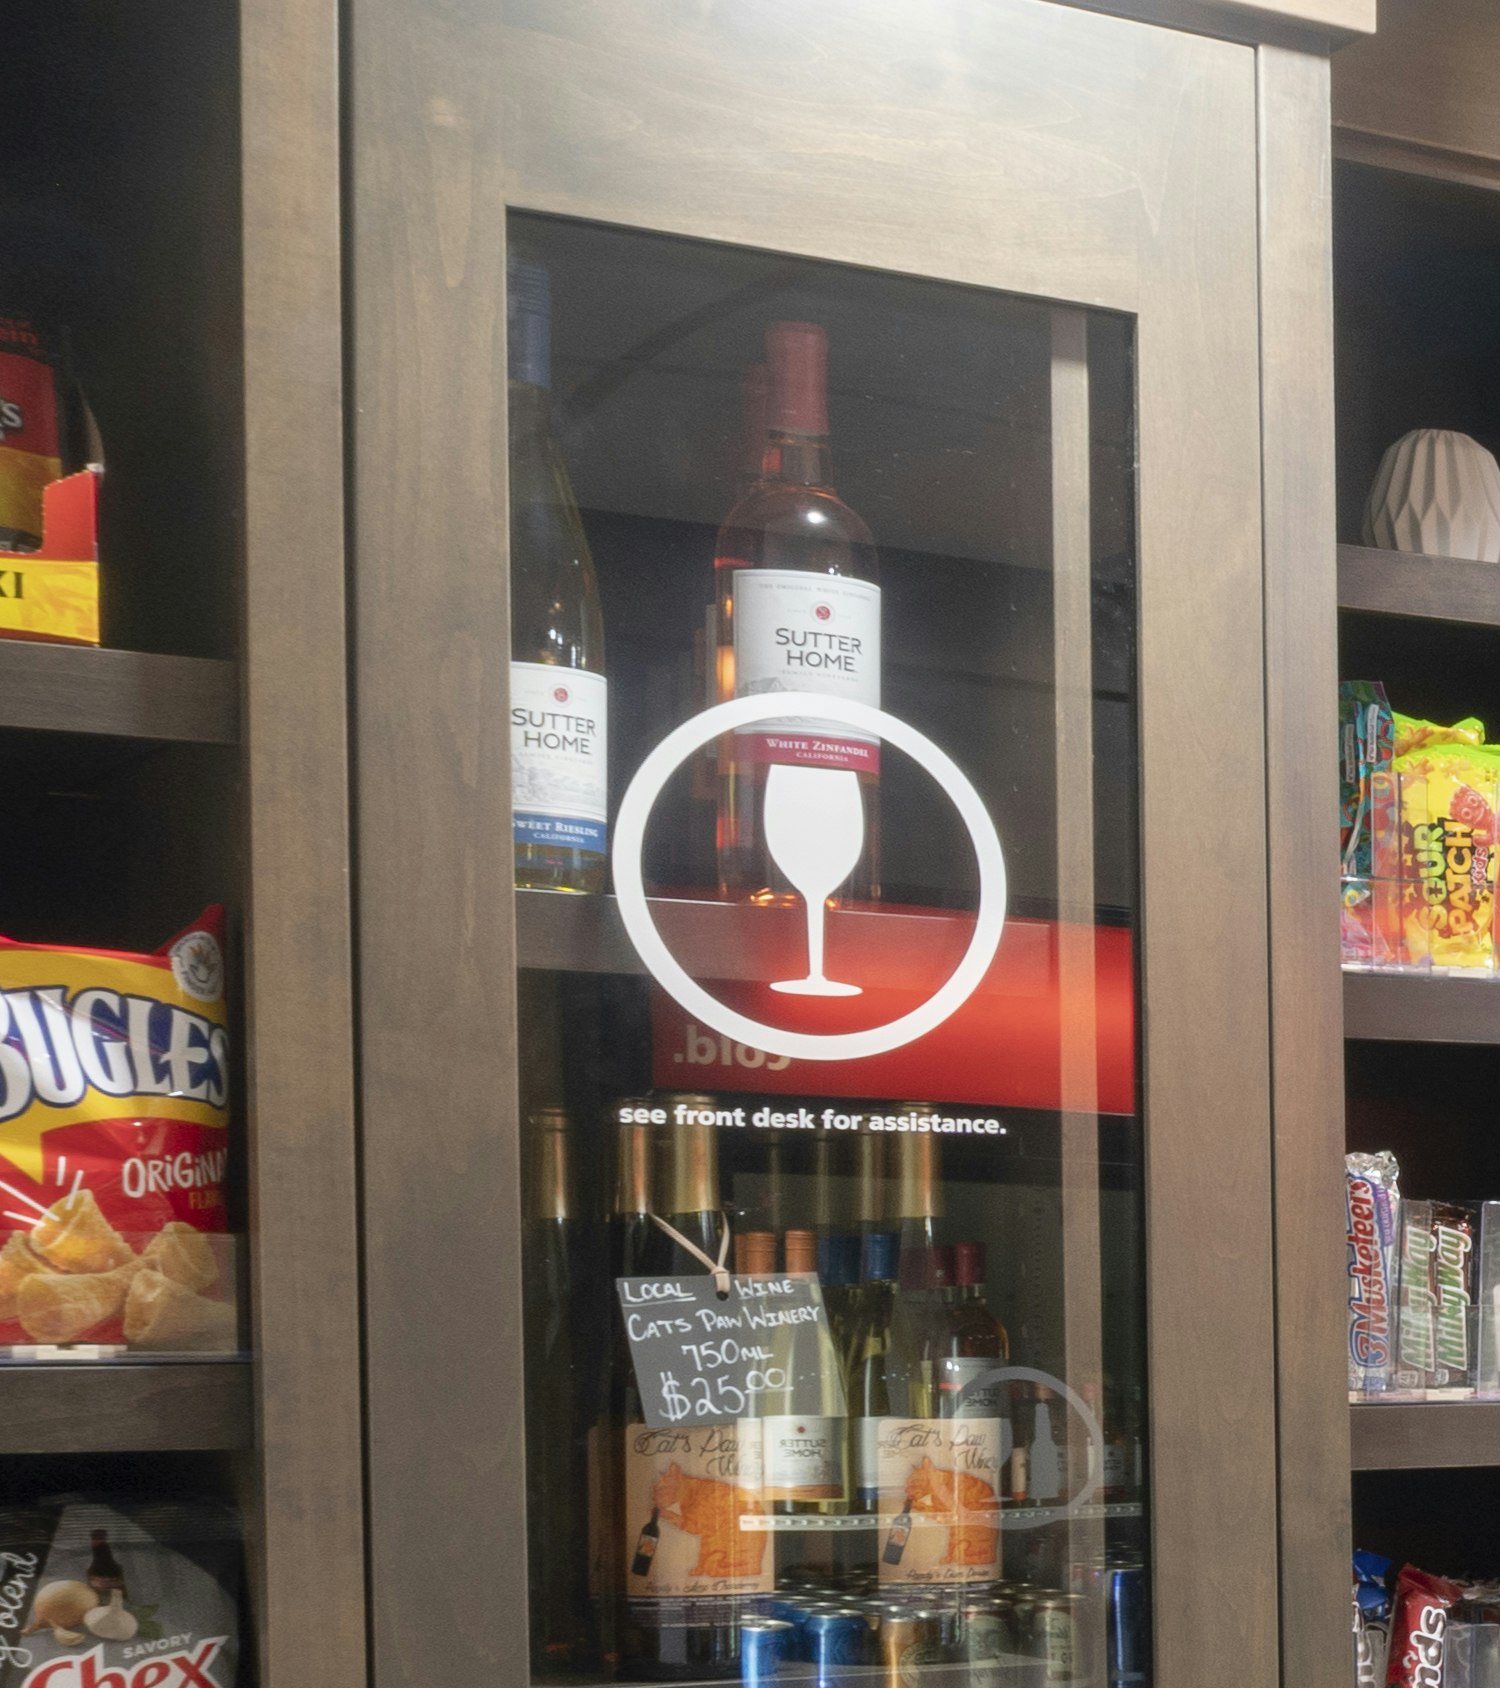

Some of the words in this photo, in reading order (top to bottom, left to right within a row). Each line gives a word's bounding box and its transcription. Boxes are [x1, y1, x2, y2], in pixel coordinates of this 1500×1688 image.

[775, 627, 862, 655] SUTTER
[786, 650, 856, 673] HOME
[511, 707, 597, 737] SUTTER
[523, 730, 591, 756] HOME
[555, 820, 599, 838] RIESLING
[619, 1107, 667, 1125] see
[674, 1106, 745, 1128] front
[752, 1107, 815, 1131] desk
[821, 1110, 863, 1131] for
[869, 1113, 1007, 1135] assistance.
[623, 1281, 695, 1303] LOCAL
[735, 1279, 794, 1299] WINE
[627, 1313, 692, 1341] CATS
[696, 1309, 743, 1332] PAW
[744, 1305, 821, 1329] WINERY
[634, 1429, 691, 1456] Cat's
[122, 1632, 193, 1659] SAVORY
